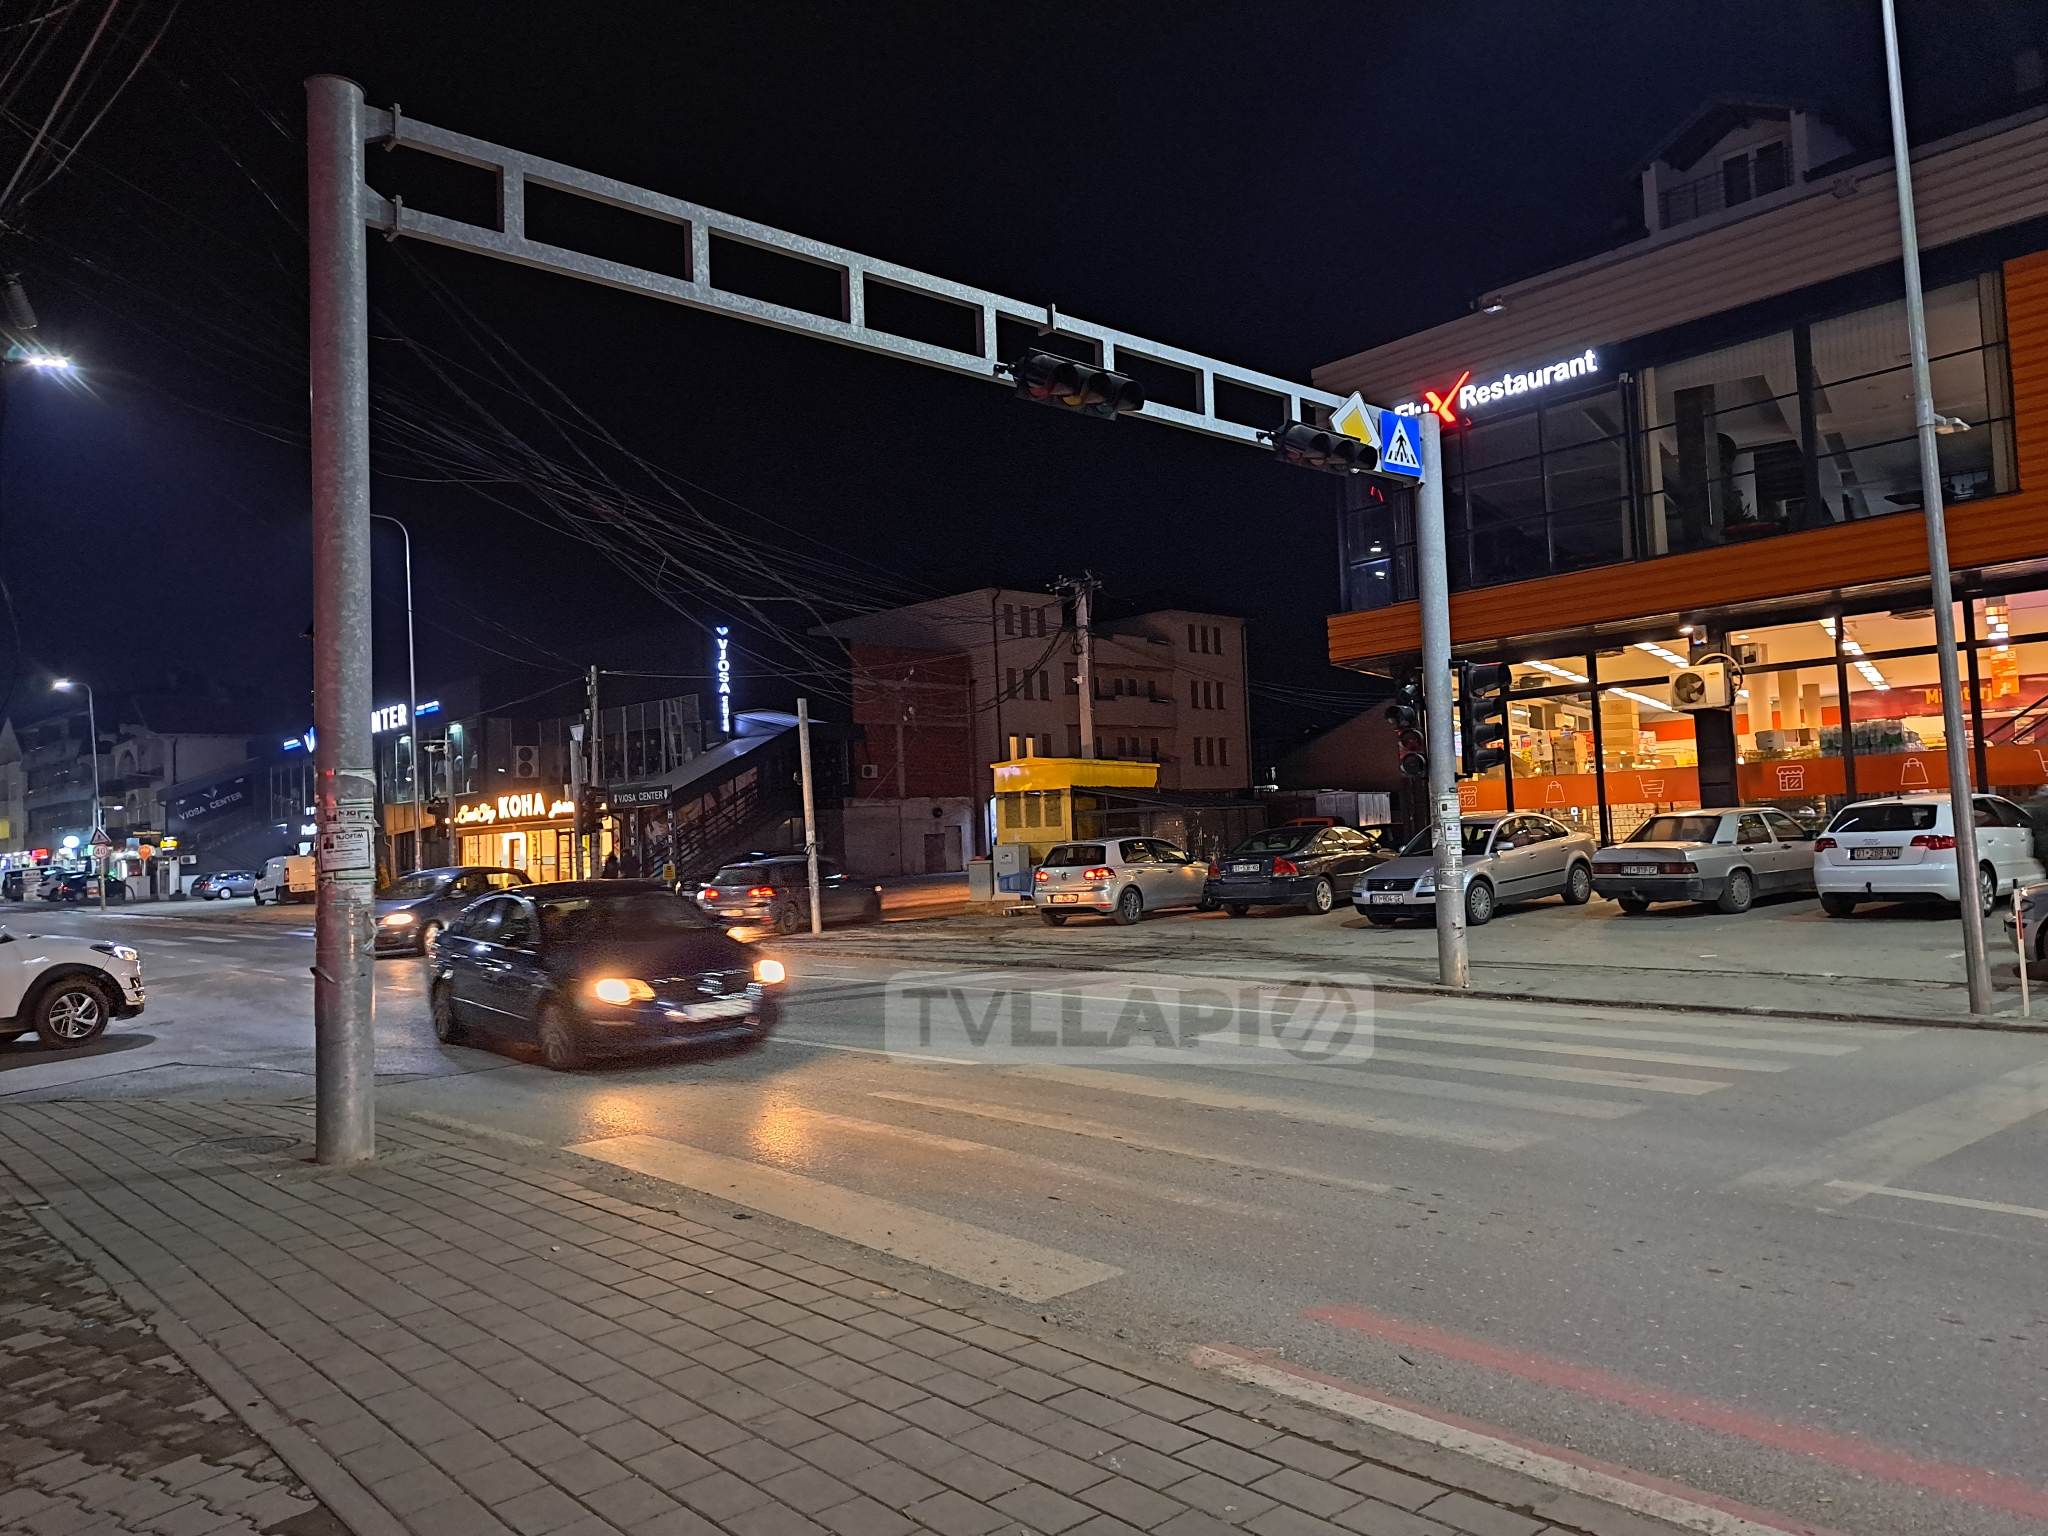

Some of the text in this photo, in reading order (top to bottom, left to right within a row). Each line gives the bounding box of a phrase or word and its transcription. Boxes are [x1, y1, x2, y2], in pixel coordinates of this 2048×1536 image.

[1459, 348, 1599, 410] Restaurant
[717, 638, 731, 694] VJOSA
[209, 791, 243, 810] CENTER
[497, 792, 546, 819] KOHA
[618, 790, 664, 803] VJOSA CENTER
[95, 848, 106, 856] 40
